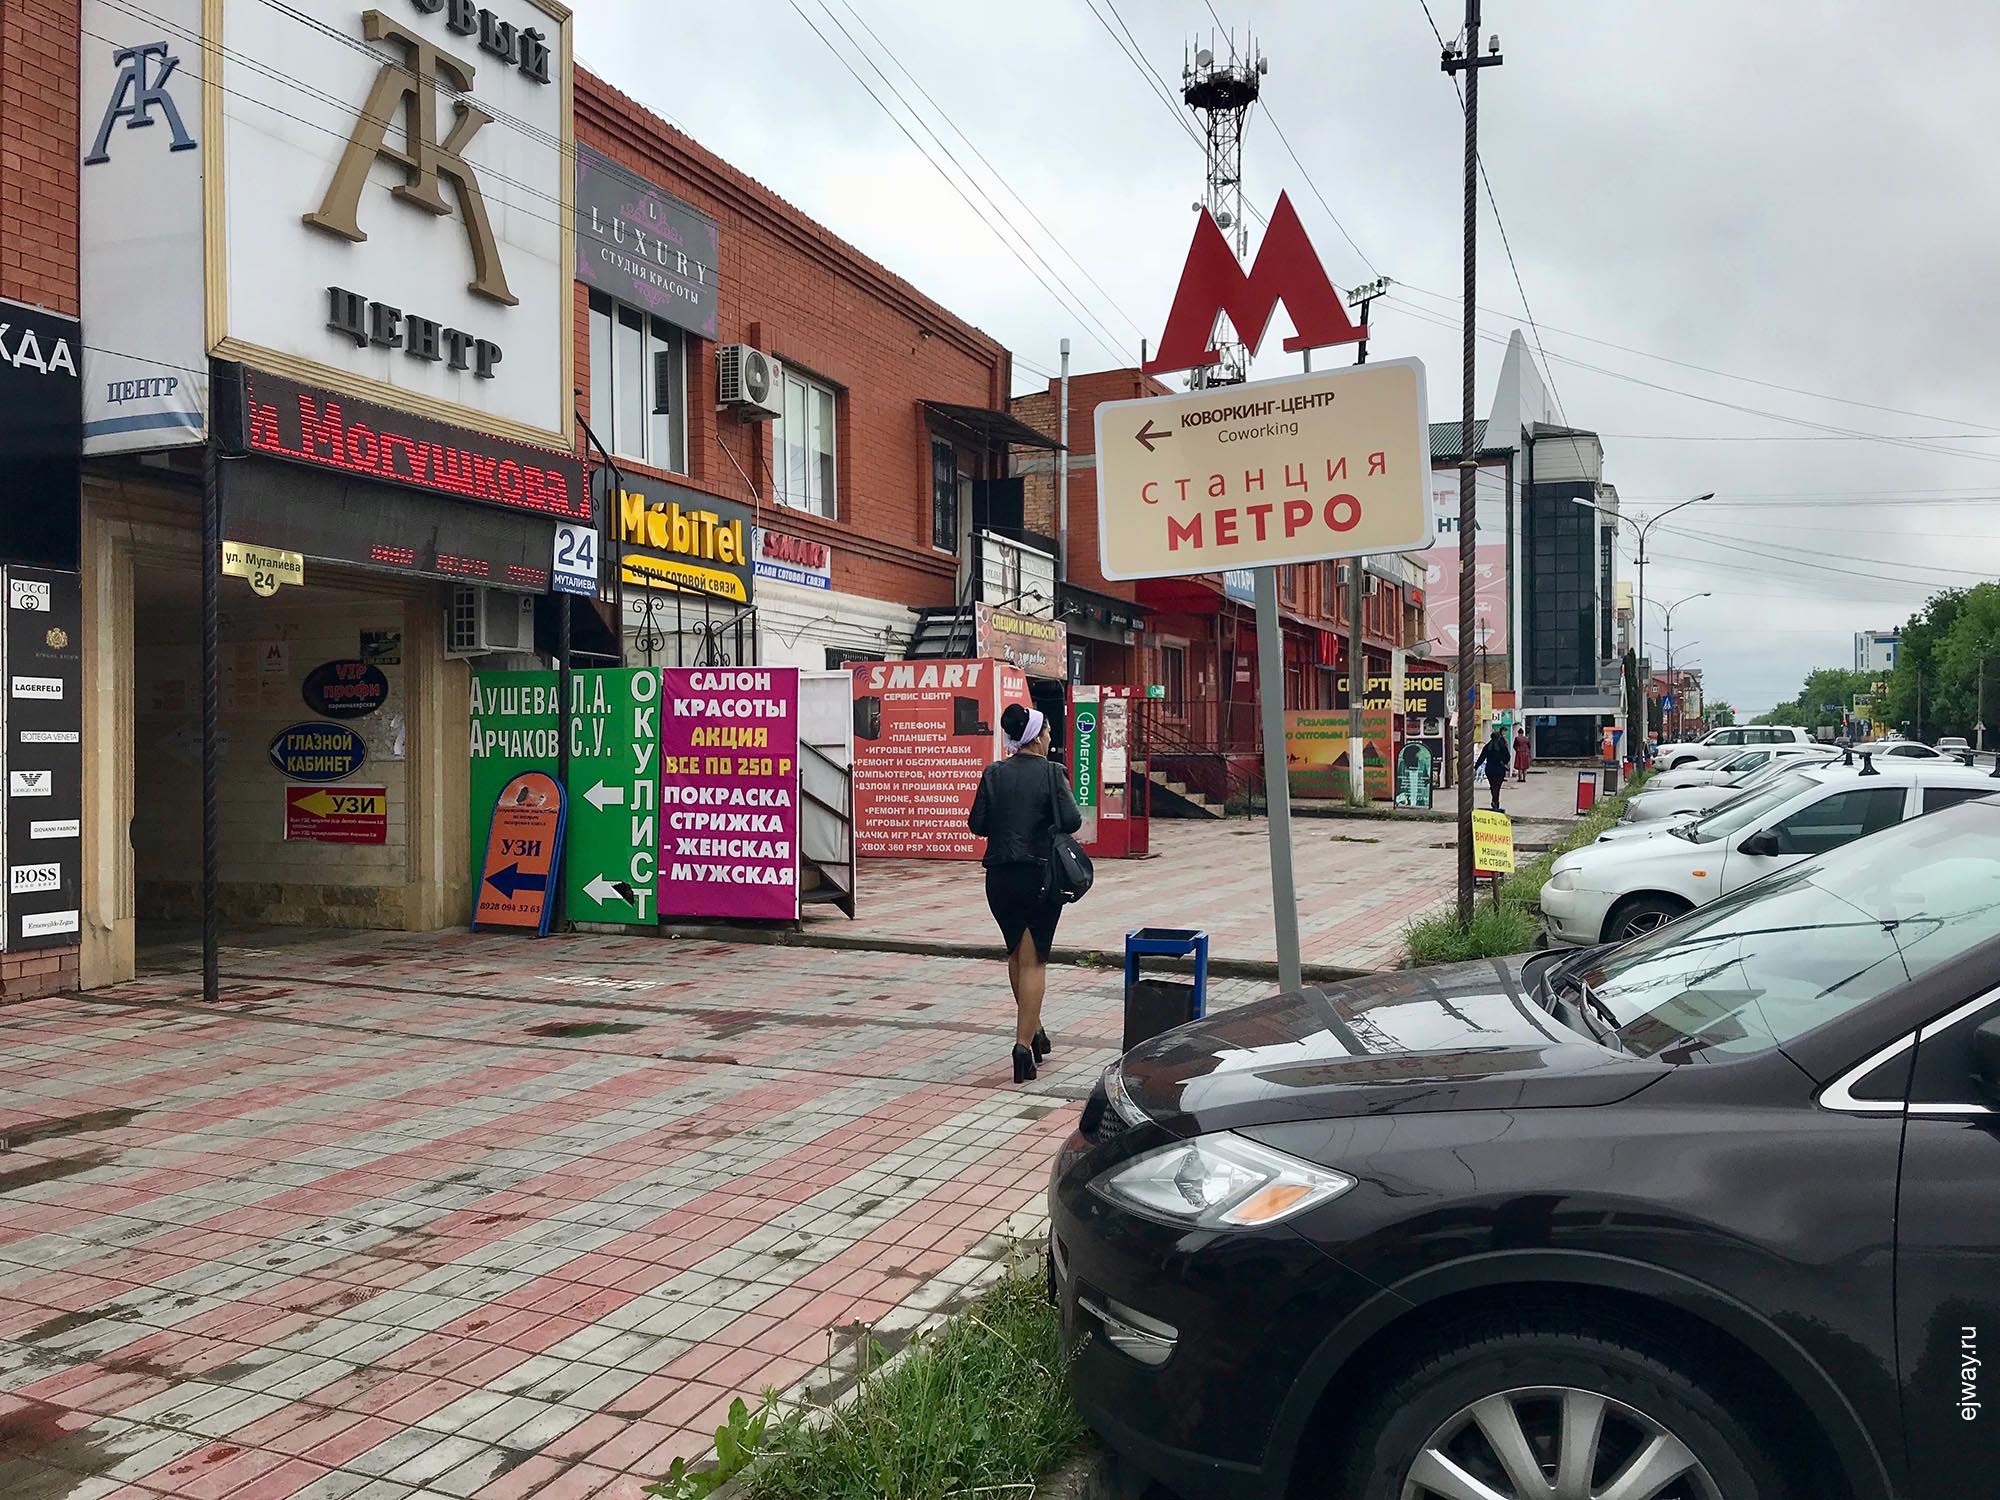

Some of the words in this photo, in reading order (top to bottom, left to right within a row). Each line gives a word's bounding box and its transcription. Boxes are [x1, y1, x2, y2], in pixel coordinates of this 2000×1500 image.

[591, 205, 707, 285] LUXURY
[601, 247, 646, 280] СТУДИЯ
[650, 270, 698, 304] КРАСОТЫ
[326, 286, 502, 379] ЦЕНТР
[107, 377, 178, 405] ЦЕНТР
[1181, 391, 1335, 428] КОВОРКИНГ-ЦЕНТР
[1217, 421, 1299, 443] Coworking
[1167, 493, 1362, 551] МЕТРО
[558, 528, 593, 570] 24
[762, 531, 829, 569] SMART
[225, 552, 241, 564] ул.
[246, 553, 301, 572] Муталиева
[254, 571, 275, 589] 24
[554, 574, 596, 592] МУТАЛИЕВА
[755, 563, 777, 579] САЛОН
[777, 569, 806, 585] СОТОВОЙ
[806, 575, 826, 588] СВЯЗИ
[12, 582, 49, 595] GUCCI
[335, 664, 367, 680] VIP
[689, 672, 771, 691] САЛОН
[868, 663, 984, 690] SMART
[15, 684, 61, 692] LAGERFELD
[323, 681, 381, 701] профи
[571, 675, 612, 714] Л.А.
[884, 692, 919, 701] СЕРВИС
[921, 692, 951, 701] ЦЕНТР
[673, 699, 787, 718] КРАСОТЫ
[21, 732, 52, 741] BOTTEGA
[53, 733, 78, 741] VENETA
[287, 731, 352, 750] ГЛАЗНОЙ
[571, 717, 612, 757] С.У.
[690, 727, 768, 749] АКЦИЯ
[914, 746, 971, 754] ПРИСТАВКИ
[287, 756, 352, 772] КАБИНЕТ
[665, 756, 700, 775] ВСЕ
[706, 757, 732, 775] ПО
[738, 758, 773, 776] 250
[779, 758, 792, 776] Р
[896, 758, 903, 766] И
[905, 758, 983, 767] ОБСЛУЖИВАНИЕ
[1079, 734, 1090, 806] МЕГАФОН
[928, 770, 983, 779] НОУТБУКОВ
[630, 671, 657, 919] ОКУЛИСТ
[664, 786, 792, 807] ПОКРАСКА
[893, 783, 900, 791] И
[902, 783, 954, 791] ПРОШИВКА
[957, 783, 978, 791] IPAD
[332, 797, 375, 813] УЗИ
[875, 795, 912, 804] IPHONE,
[914, 795, 960, 803] SAMSUNG
[908, 807, 915, 815] И
[917, 807, 970, 816] ПРОШИВКА
[670, 812, 784, 833] СТРИЖКА
[866, 819, 910, 827] ИГРОВЫХ
[912, 819, 969, 828] ПРИСТАВОК
[891, 831, 909, 840] ИГР
[911, 832, 933, 840] PLAY
[935, 832, 976, 841] STATION
[501, 839, 542, 857] УЗИ
[861, 843, 886, 852] XBOX
[888, 844, 904, 852] 360
[906, 844, 924, 852] PSP
[926, 844, 951, 852] XBOX
[954, 844, 974, 853] ONE
[15, 868, 57, 884] BOSS
[480, 902, 500, 911] 8928
[517, 904, 529, 912] 32
